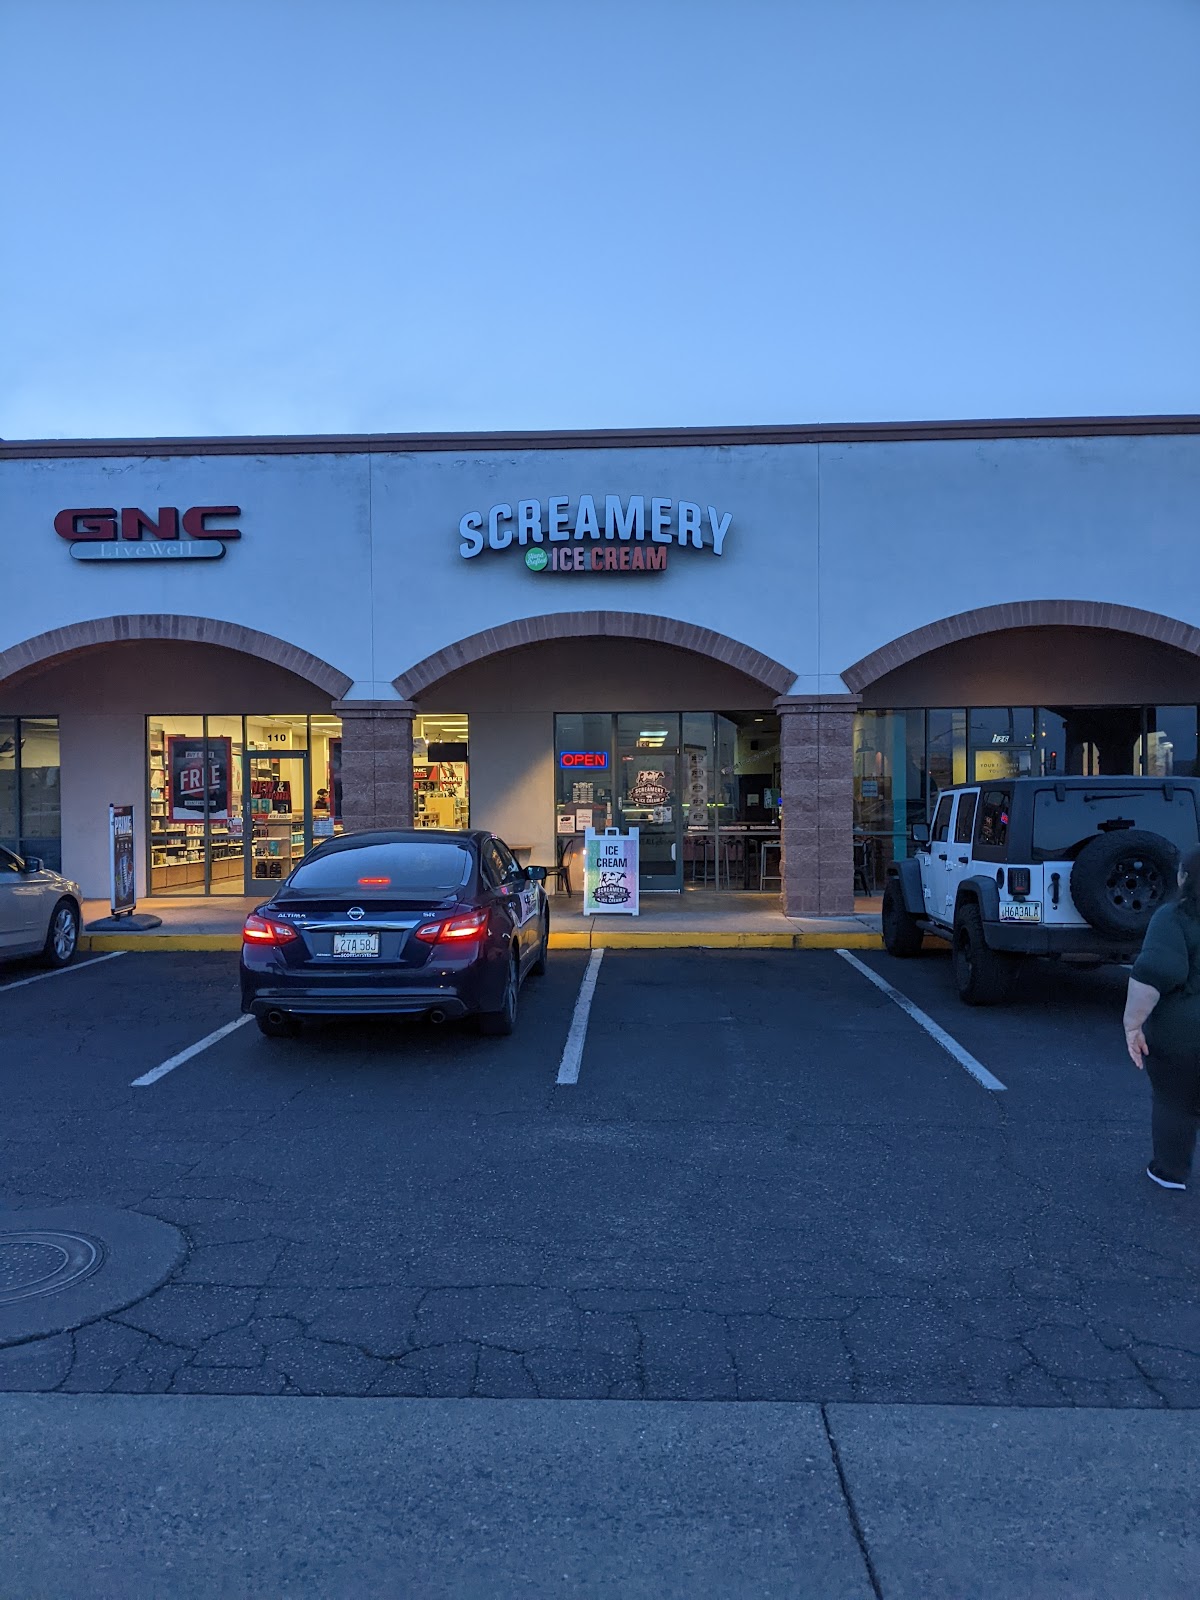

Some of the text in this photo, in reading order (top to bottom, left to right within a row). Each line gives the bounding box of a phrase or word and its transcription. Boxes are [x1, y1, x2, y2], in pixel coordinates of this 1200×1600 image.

[54, 506, 241, 540] GNC
[459, 494, 733, 559] SCREAMERY
[552, 546, 667, 571] ICE CREAM
[267, 733, 286, 742] 110
[562, 754, 605, 766] OPEN
[180, 764, 220, 790] FRE
[635, 786, 664, 794] SCREAMERY
[115, 816, 132, 836] PRIME
[605, 845, 619, 856] ICE
[596, 857, 628, 868] CREAM
[340, 939, 377, 951] 27A 58J
